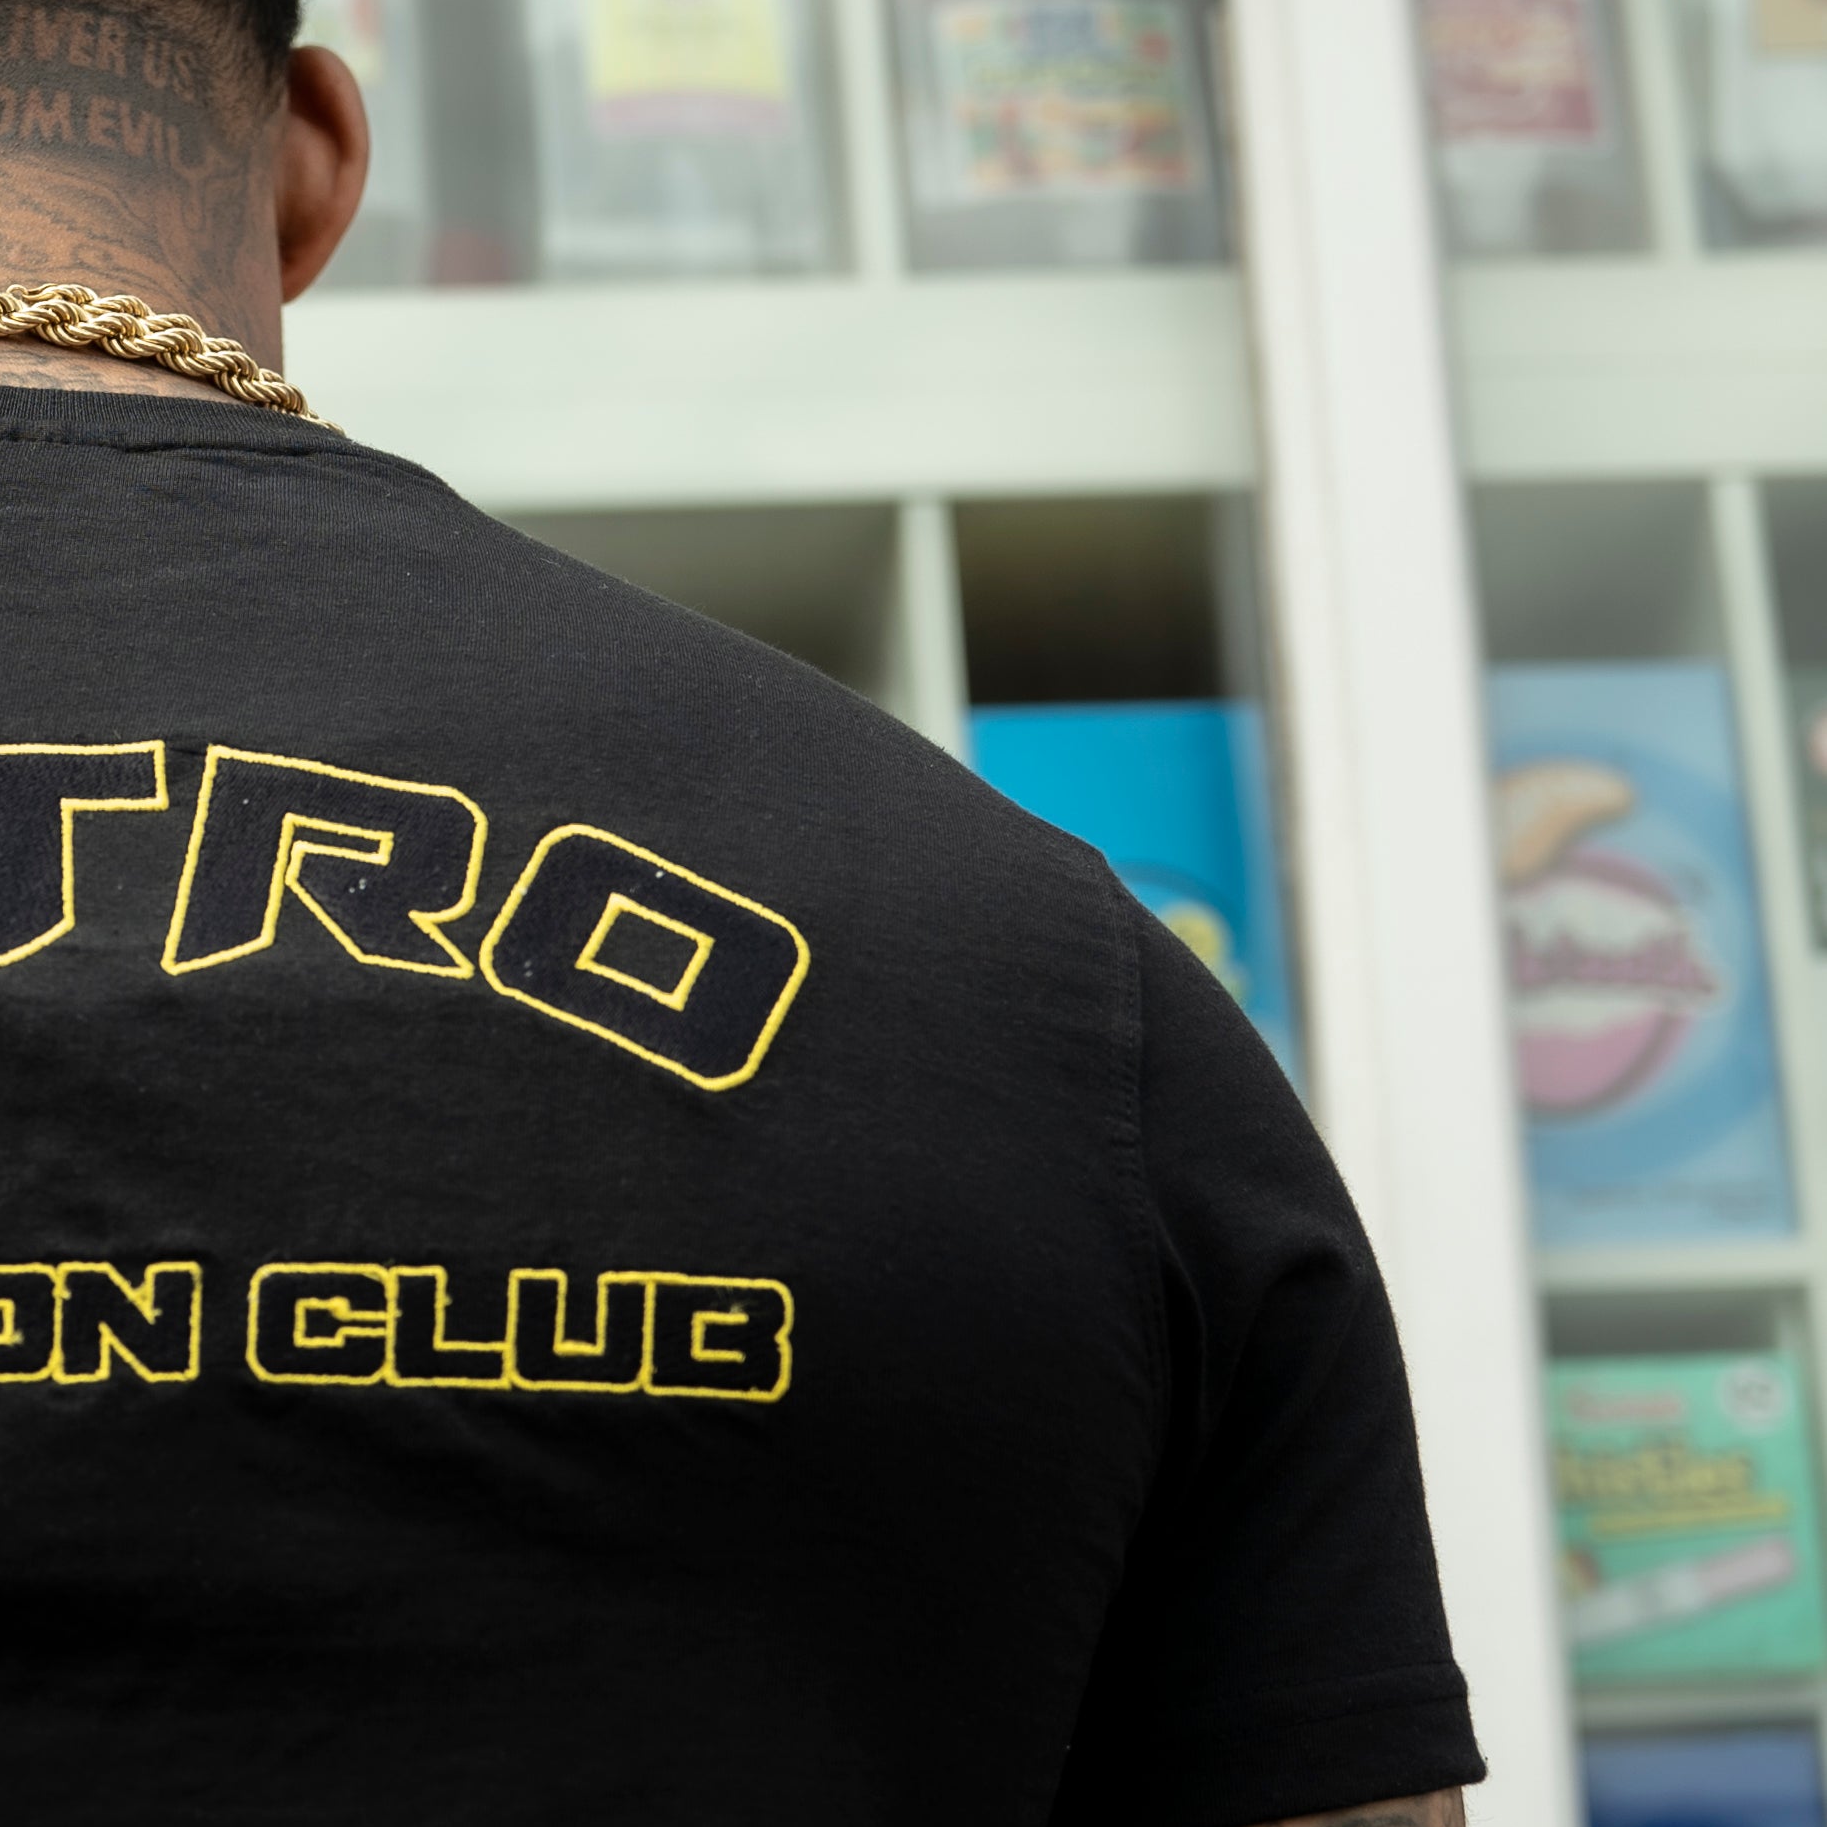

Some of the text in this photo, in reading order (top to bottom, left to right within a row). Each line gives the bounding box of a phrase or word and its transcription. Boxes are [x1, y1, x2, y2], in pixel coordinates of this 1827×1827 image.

[142, 36, 198, 99] US
[86, 96, 196, 174] EVIL
[246, 1262, 793, 1401] CLUB
